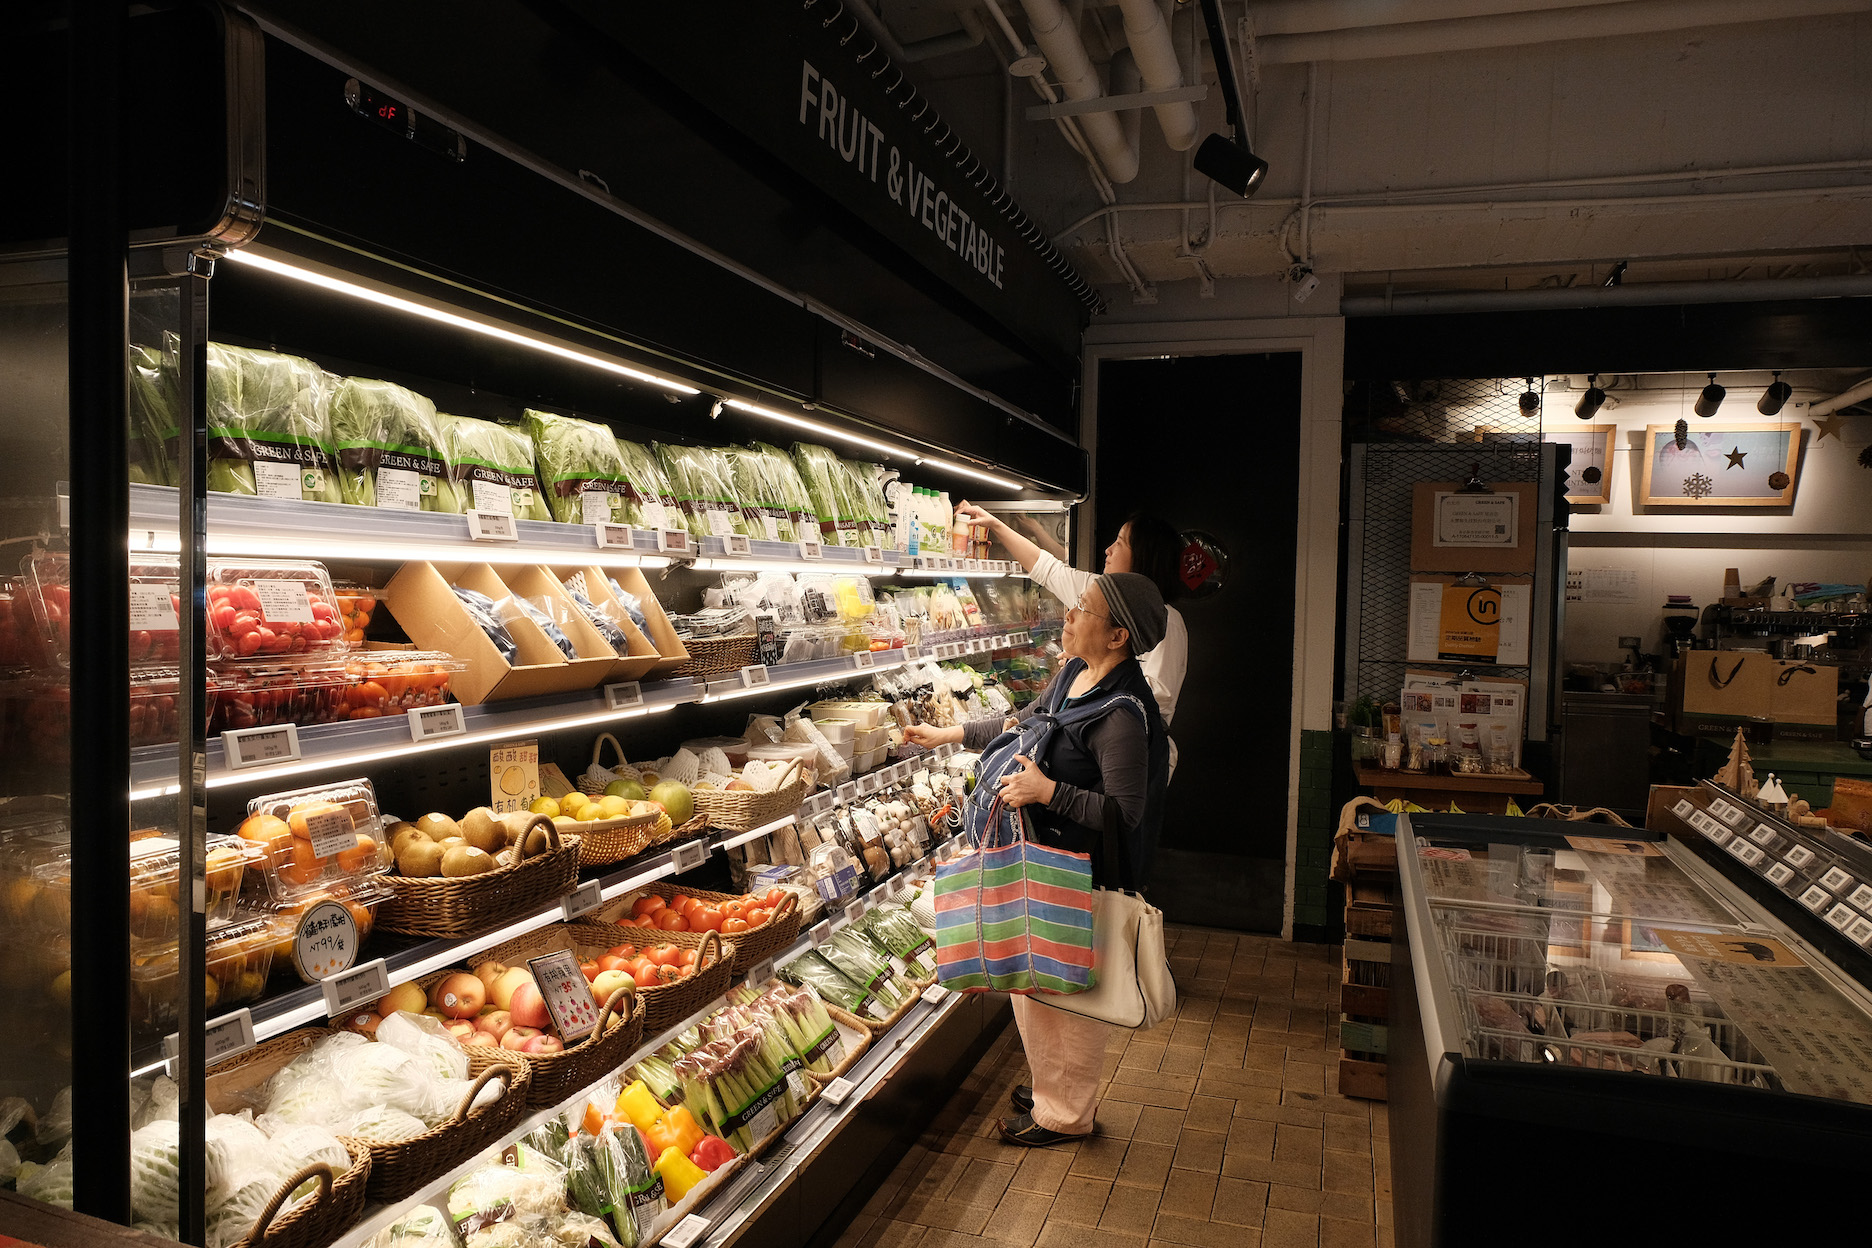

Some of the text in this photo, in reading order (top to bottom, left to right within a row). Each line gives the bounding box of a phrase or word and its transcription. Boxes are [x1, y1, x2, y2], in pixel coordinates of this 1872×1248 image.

[799, 59, 1006, 290] FRUIT & VEGETABLE
[252, 445, 292, 460] GREEN
[294, 448, 303, 460] &
[380, 454, 441, 474] GREEN & SAFE
[473, 468, 534, 487] GREEN & SAFE
[581, 481, 606, 491] GREEN
[609, 484, 626, 493] SAFE
[1698, 724, 1752, 734] GREEN & SFE
[741, 1101, 764, 1122] GREEN
[762, 1096, 769, 1106] &
